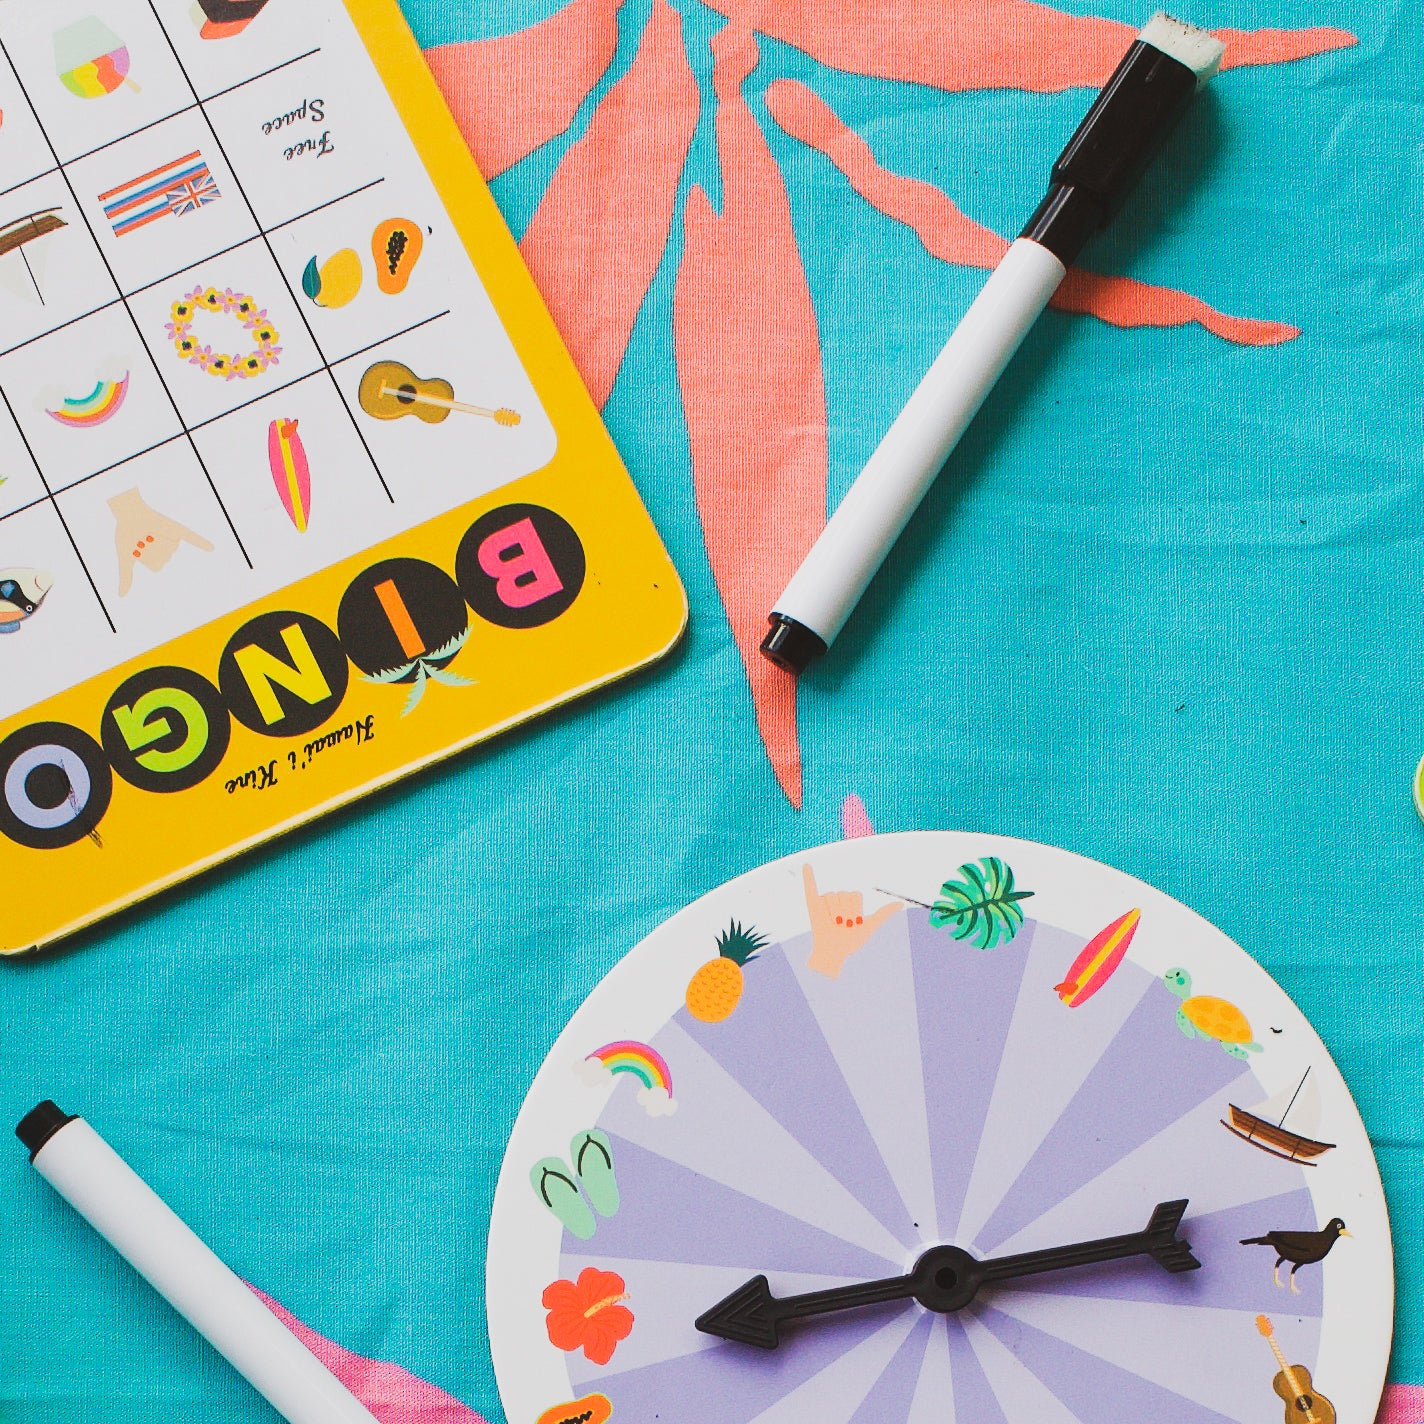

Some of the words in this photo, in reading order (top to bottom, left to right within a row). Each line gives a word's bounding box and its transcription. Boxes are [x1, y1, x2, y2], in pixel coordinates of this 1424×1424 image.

[261, 98, 325, 136] Space
[283, 130, 335, 160] Free
[4, 516, 564, 829] BINGO
[224, 759, 278, 794] Kine
